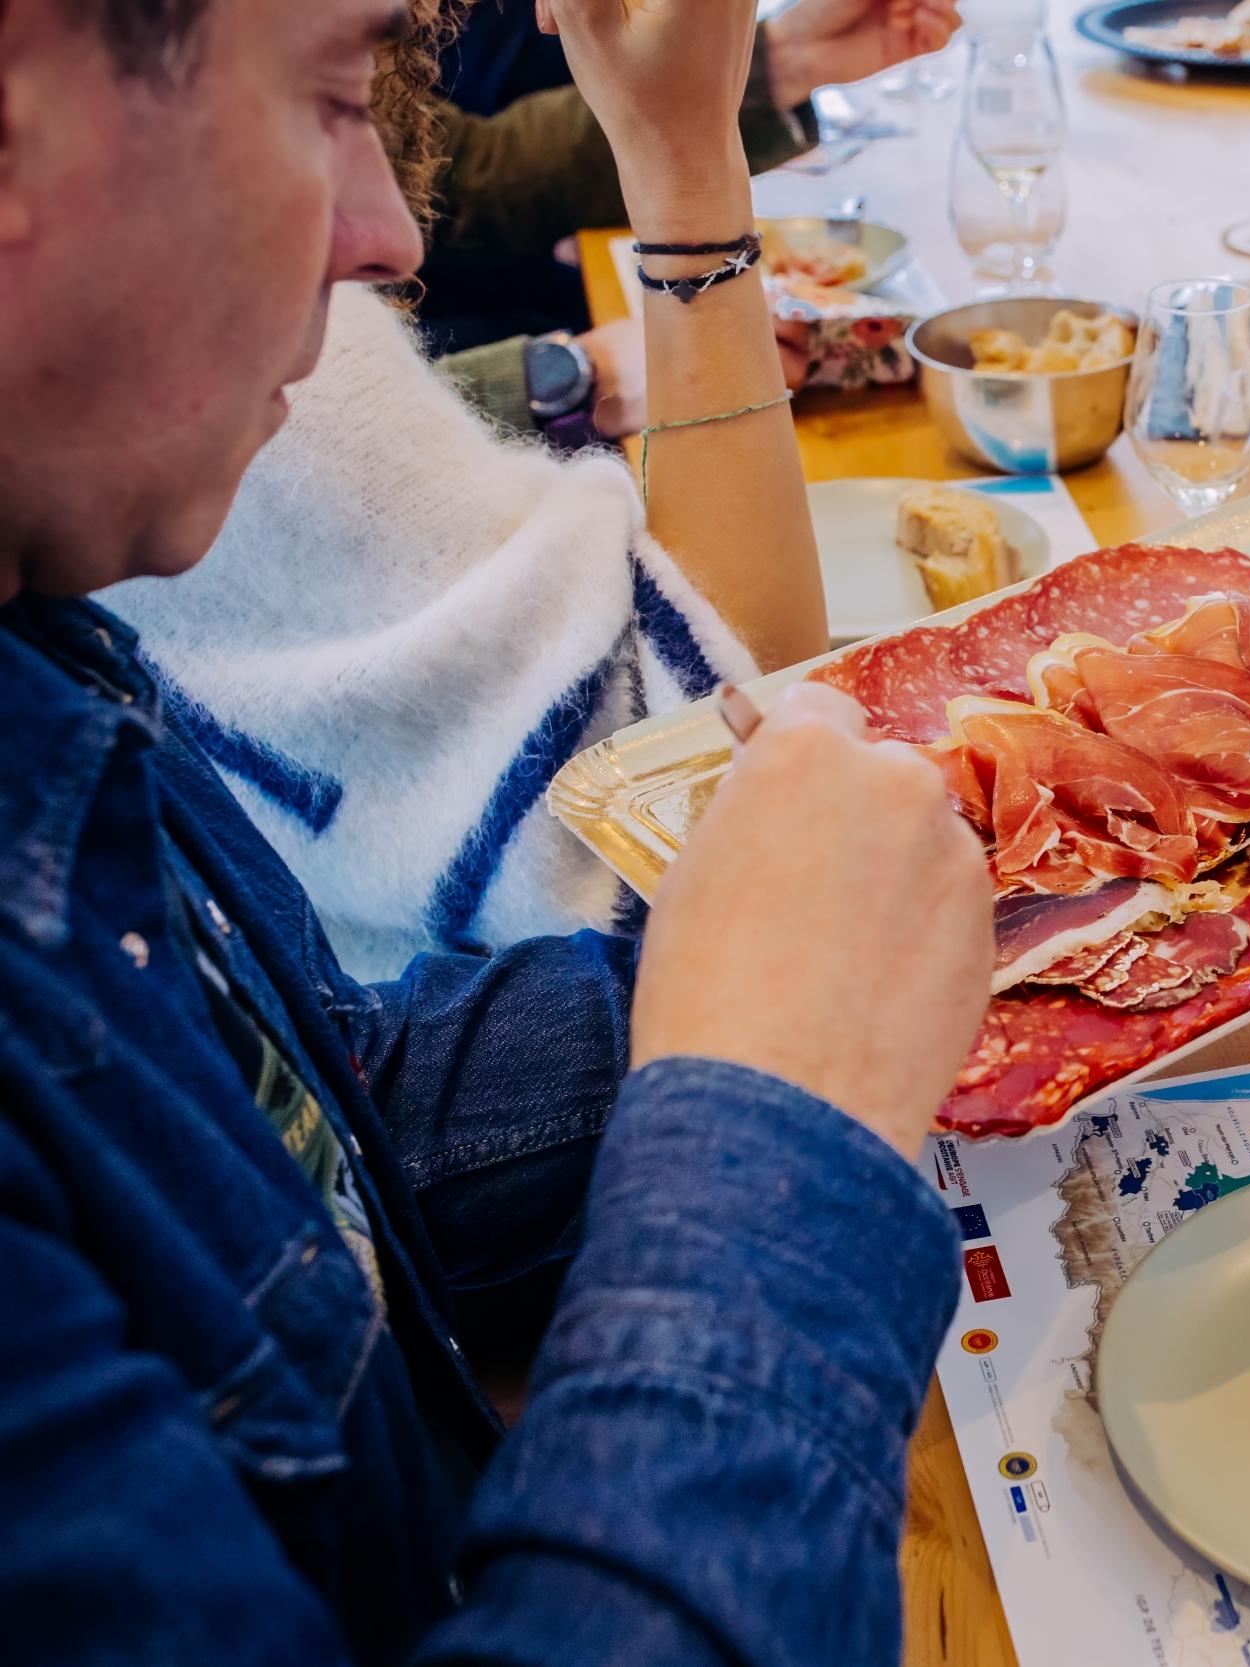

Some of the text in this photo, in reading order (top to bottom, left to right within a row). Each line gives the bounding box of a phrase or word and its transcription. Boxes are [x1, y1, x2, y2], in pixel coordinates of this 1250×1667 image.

[948, 1171, 958, 1186] AGIT
[954, 1167, 970, 1198] S'ENGAGE
[980, 1268, 995, 1298] Occitanie
